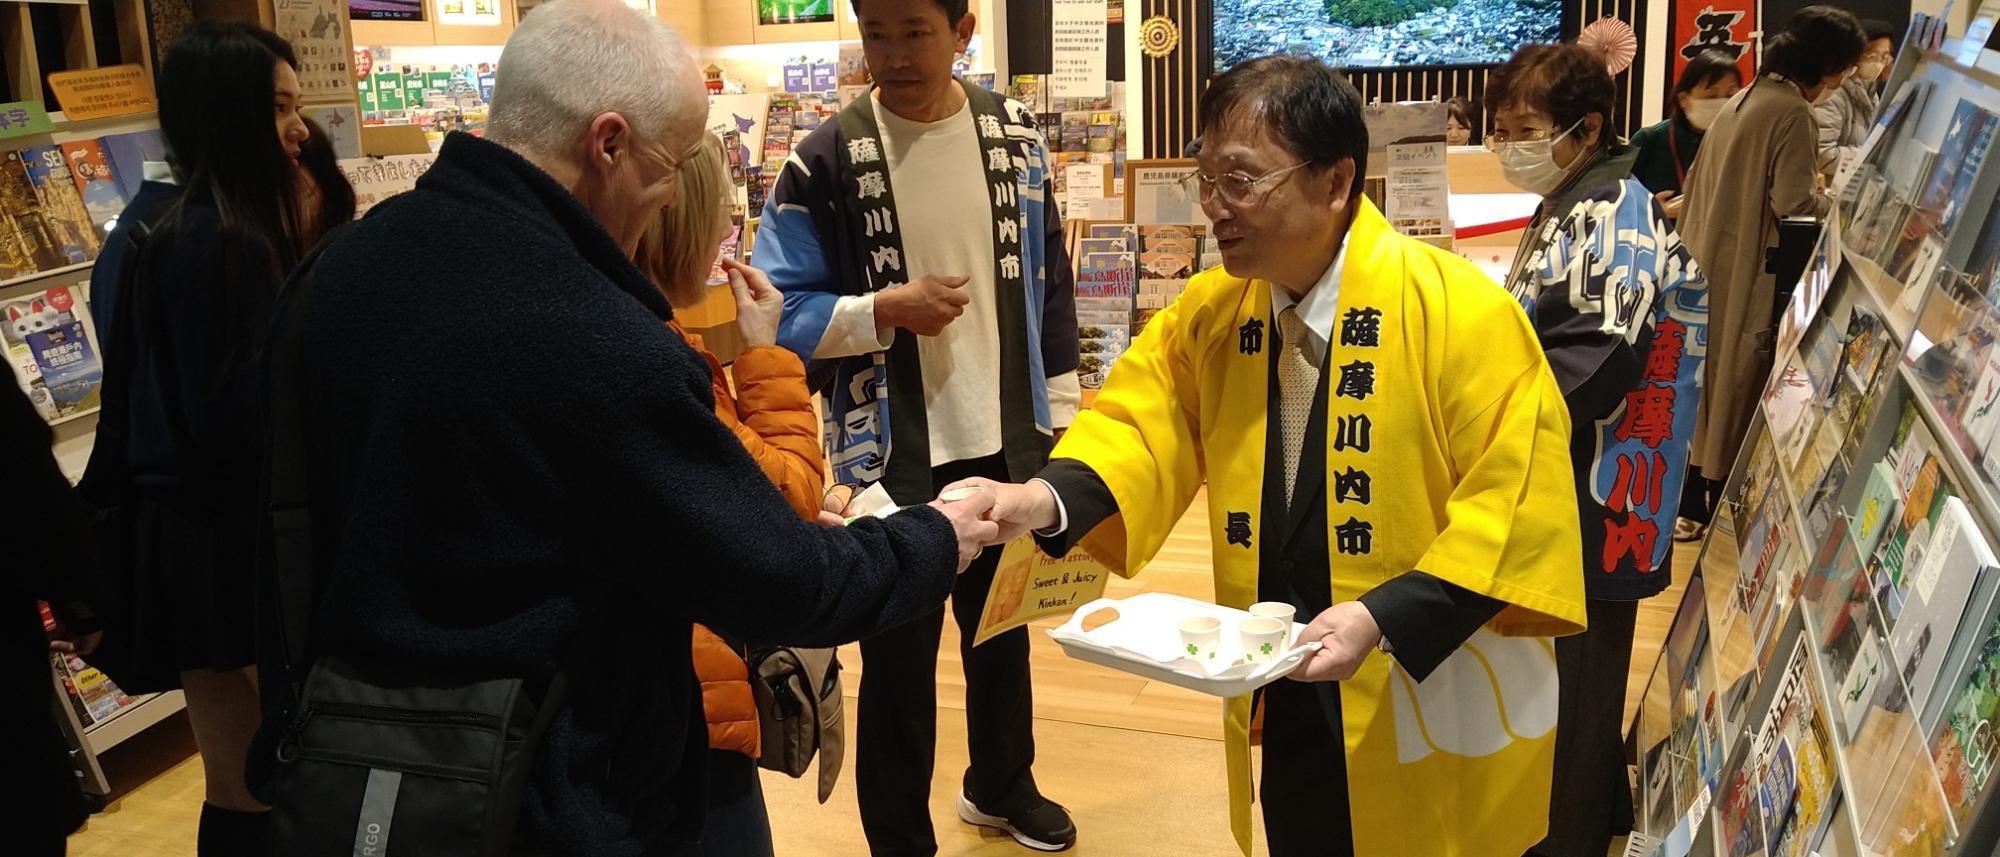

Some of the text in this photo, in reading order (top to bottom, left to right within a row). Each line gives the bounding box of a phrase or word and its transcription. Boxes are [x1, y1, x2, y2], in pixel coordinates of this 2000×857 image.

[1680, 6, 1750, 61] 五
[847, 137, 904, 290] 薩摩川内
[978, 113, 1020, 280] 薩摩川内市
[1333, 307, 1382, 556] 薩摩川内市
[1032, 570, 1098, 590] Sweet & Juicy
